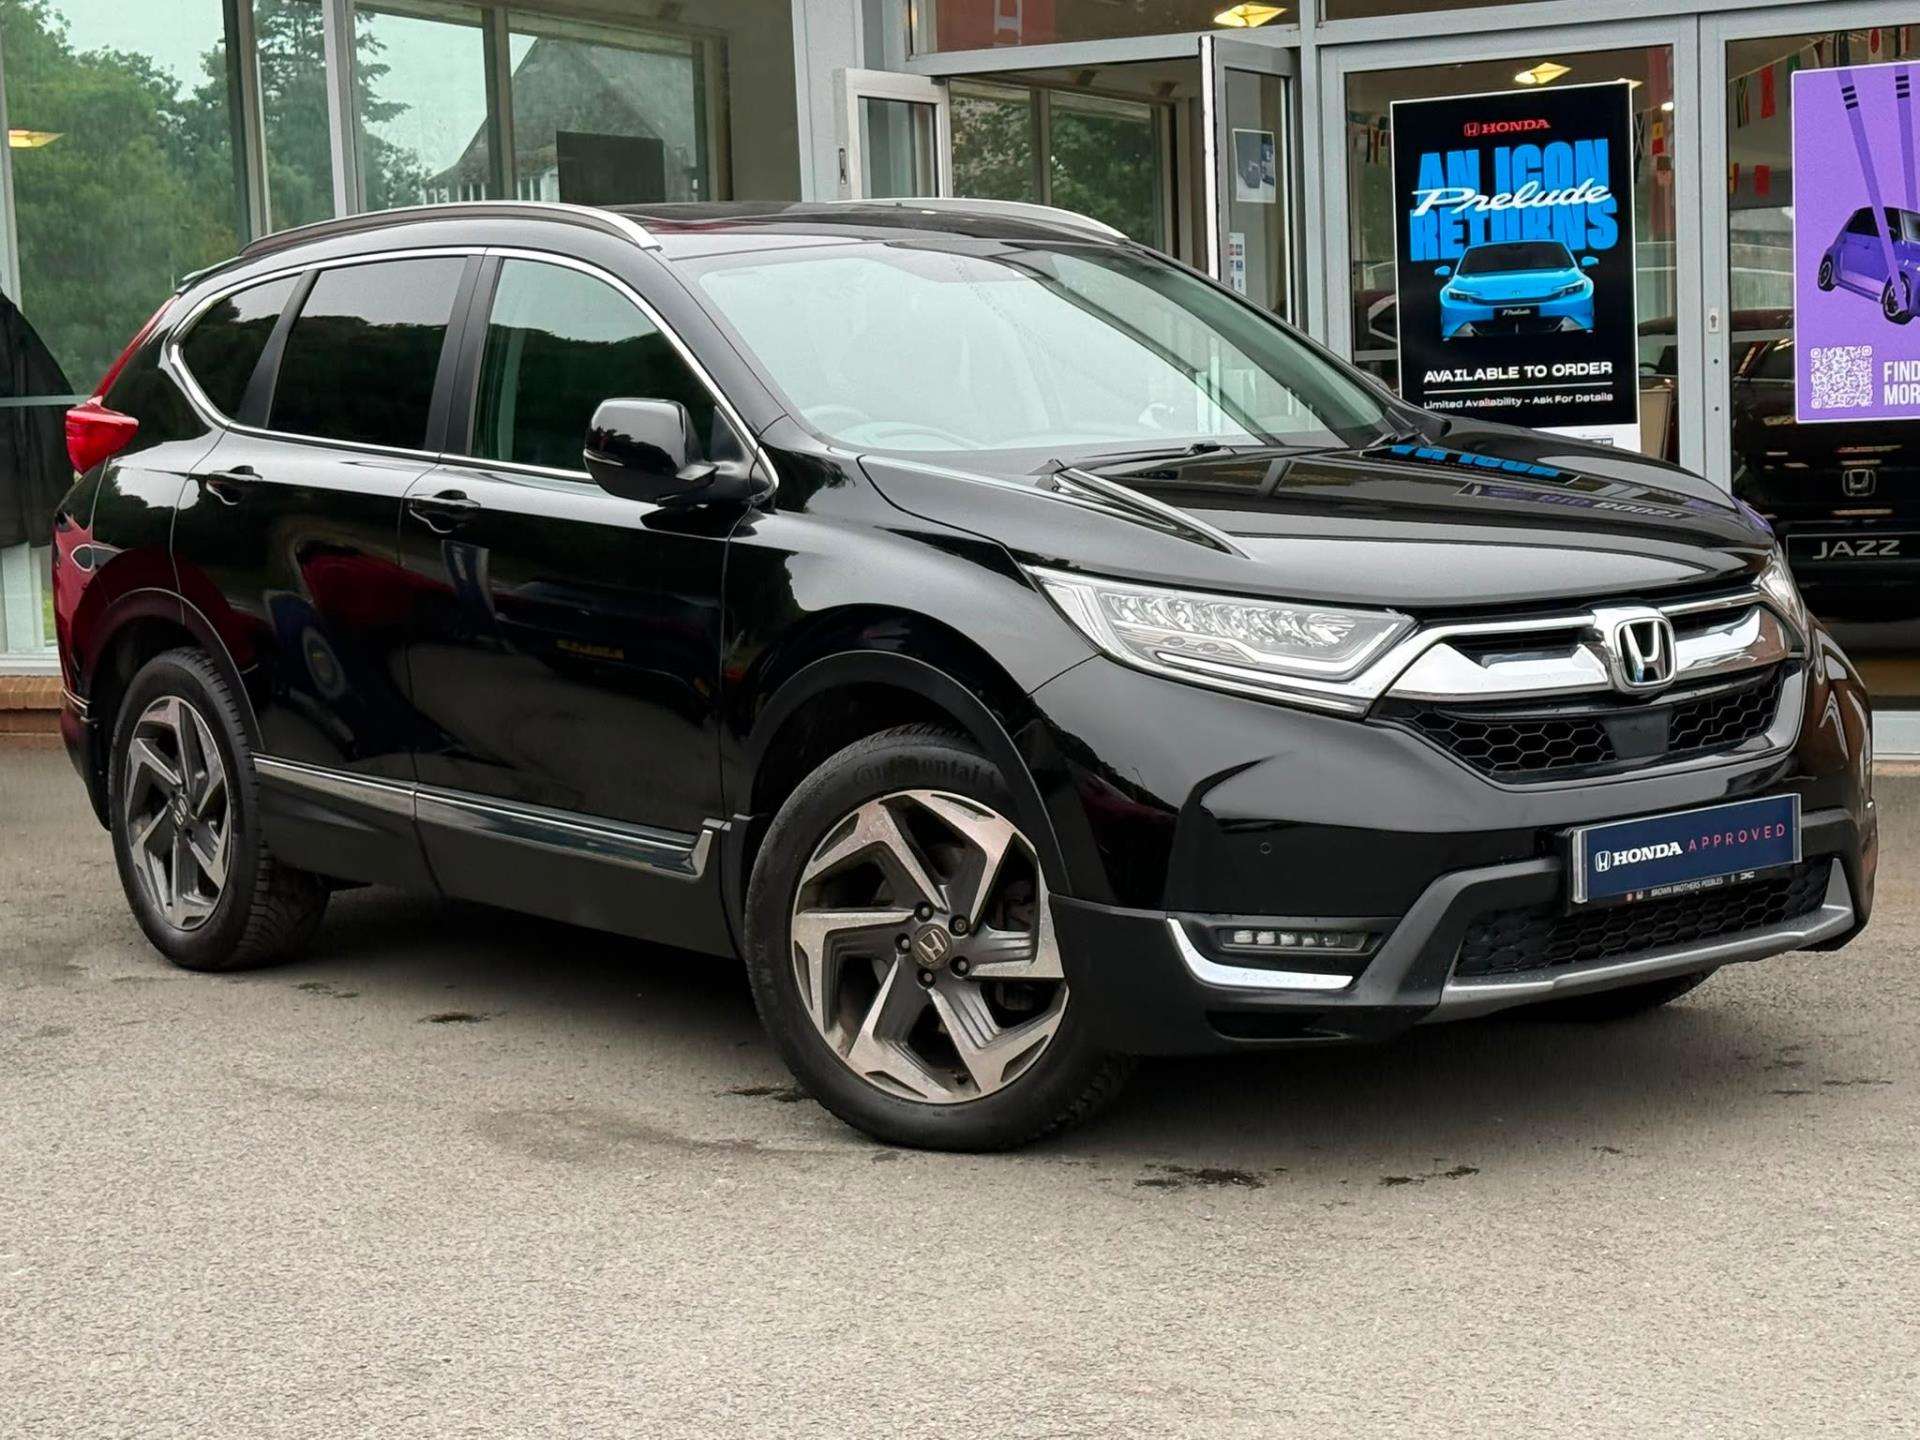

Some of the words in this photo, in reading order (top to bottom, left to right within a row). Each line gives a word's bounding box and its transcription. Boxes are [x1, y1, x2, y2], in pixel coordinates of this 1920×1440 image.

[1482, 119, 1551, 134] HONDA
[1416, 149, 1480, 206] AN
[1495, 138, 1609, 196] ICON
[1411, 177, 1612, 217] Prelude
[1410, 198, 1618, 261] RETURNS
[1424, 366, 1520, 383] AVAILABLE
[1524, 364, 1547, 378] TO
[1552, 361, 1613, 376] ORDER
[1883, 360, 1920, 382] FIND
[1424, 400, 1463, 410] Limited
[1464, 396, 1522, 409] Availability
[1532, 394, 1553, 404] Ask
[1555, 394, 1573, 403] For
[1575, 392, 1613, 402] Details
[1812, 540, 1900, 560] JAZZ
[1612, 841, 1683, 866] HONDA
[1688, 823, 1786, 851] APPROVED
[1673, 882, 1701, 893] BROTHERS
